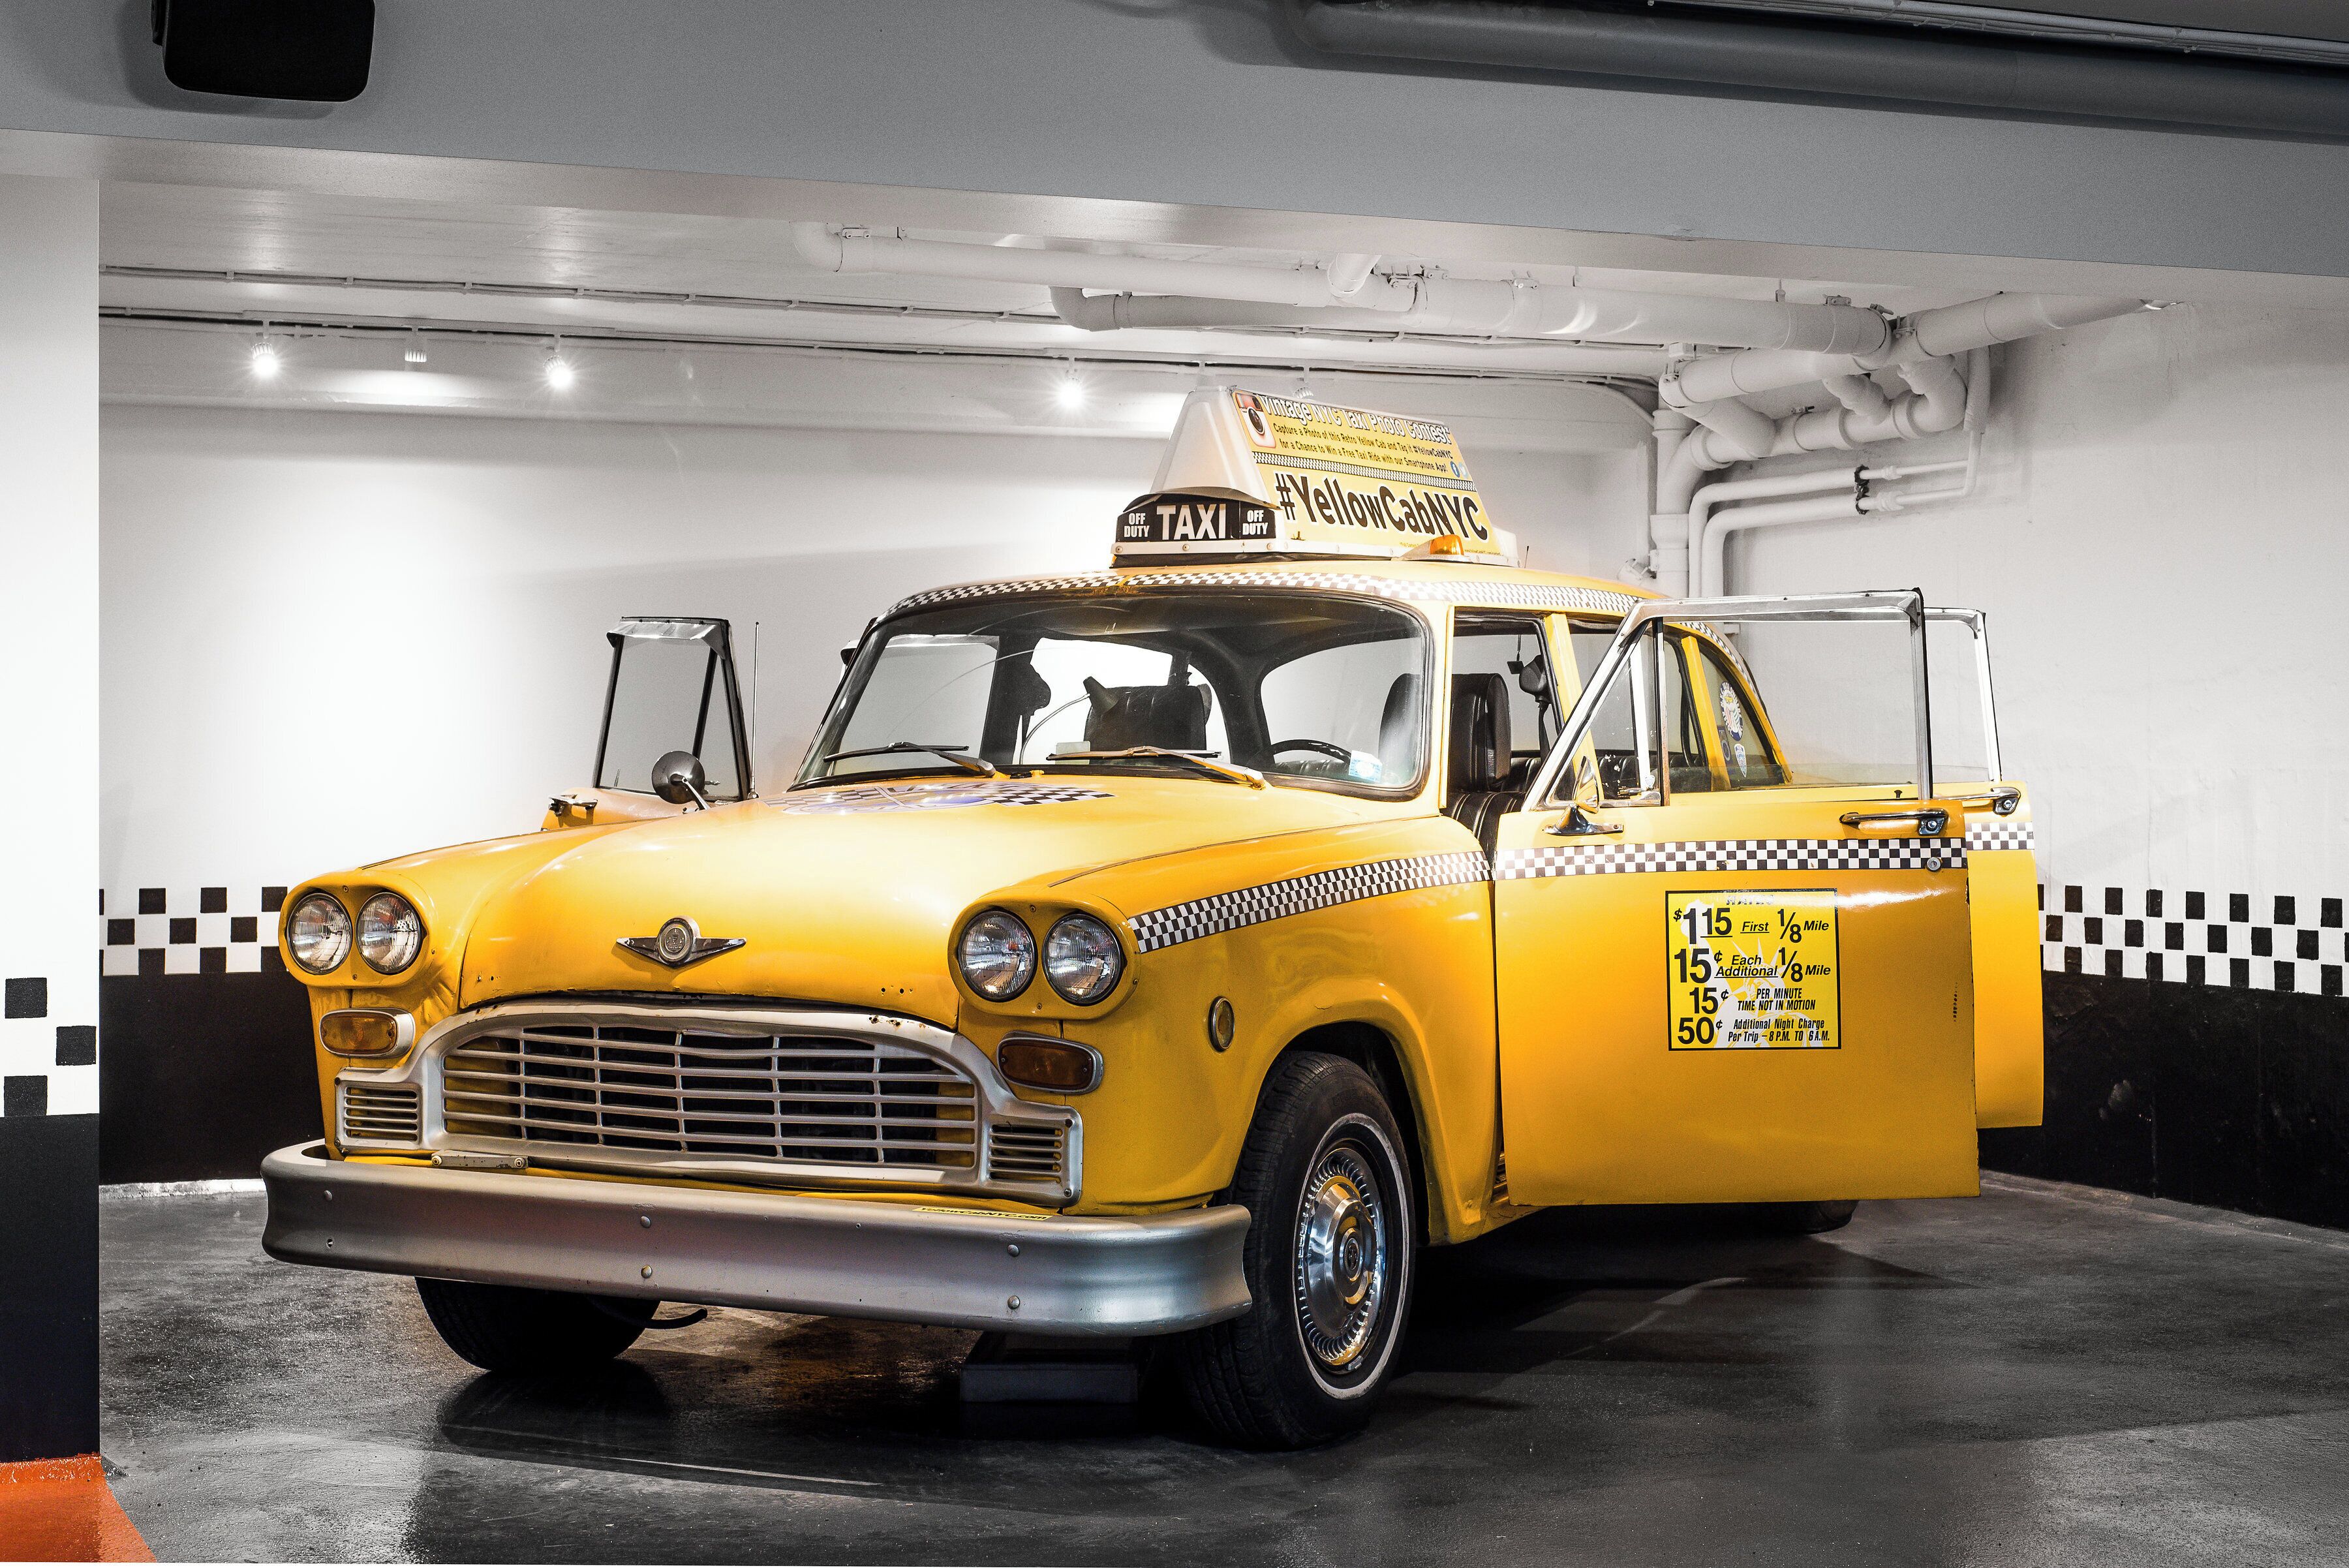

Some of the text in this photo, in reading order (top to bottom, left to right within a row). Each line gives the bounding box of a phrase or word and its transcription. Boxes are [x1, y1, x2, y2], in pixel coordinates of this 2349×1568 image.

[1260, 395, 1312, 425] Vintage
[1311, 405, 1342, 426] NYC
[1342, 409, 1370, 431] Taxi
[1367, 413, 1405, 437] Photo
[1273, 423, 1298, 435] Capture
[1304, 427, 1321, 438] Photo
[1329, 432, 1340, 442] this
[1341, 433, 1357, 444] Retro
[1357, 436, 1374, 447] Yellow
[1375, 439, 1386, 449] Cab
[1387, 441, 1397, 450] and
[1397, 442, 1407, 454] Tag
[1408, 444, 1413, 453] it
[1413, 445, 1453, 460] #YellowCabNYC
[1280, 438, 1289, 448] for
[1295, 441, 1317, 452] Chance
[1325, 445, 1337, 455] Win
[1342, 448, 1355, 459] Free
[1355, 450, 1368, 461] Taxi
[1368, 452, 1381, 462] Ride
[1382, 453, 1394, 464] with
[1394, 456, 1403, 465] our
[1404, 457, 1435, 471] Smartphone
[1435, 462, 1448, 474] App!
[1275, 473, 1488, 540] #YellowCabNYC
[1128, 513, 1146, 525] OFF
[1157, 504, 1226, 540] TAXI
[1247, 510, 1264, 522] OFF
[1124, 525, 1150, 538] DUTY
[1242, 523, 1268, 535] DUTY
[1742, 921, 1769, 932] First
[1804, 920, 1829, 931] Mile
[1732, 955, 1762, 966] Each
[1715, 966, 1777, 977] Additional
[1805, 964, 1831, 976] Mile
[1756, 987, 1802, 1000] PER MINUTE
[1738, 999, 1816, 1011] TIME NOT IN MOTION
[1734, 1019, 1824, 1030] Additional Night Charge
[1728, 1031, 1742, 1042] Per
[1743, 1031, 1758, 1043] Trip
[1769, 1031, 1774, 1041] 8
[1775, 1031, 1790, 1041] P.M.
[1794, 1031, 1804, 1041] TO
[1809, 1031, 1814, 1041] 6
[1815, 1030, 1830, 1041] A.M.
